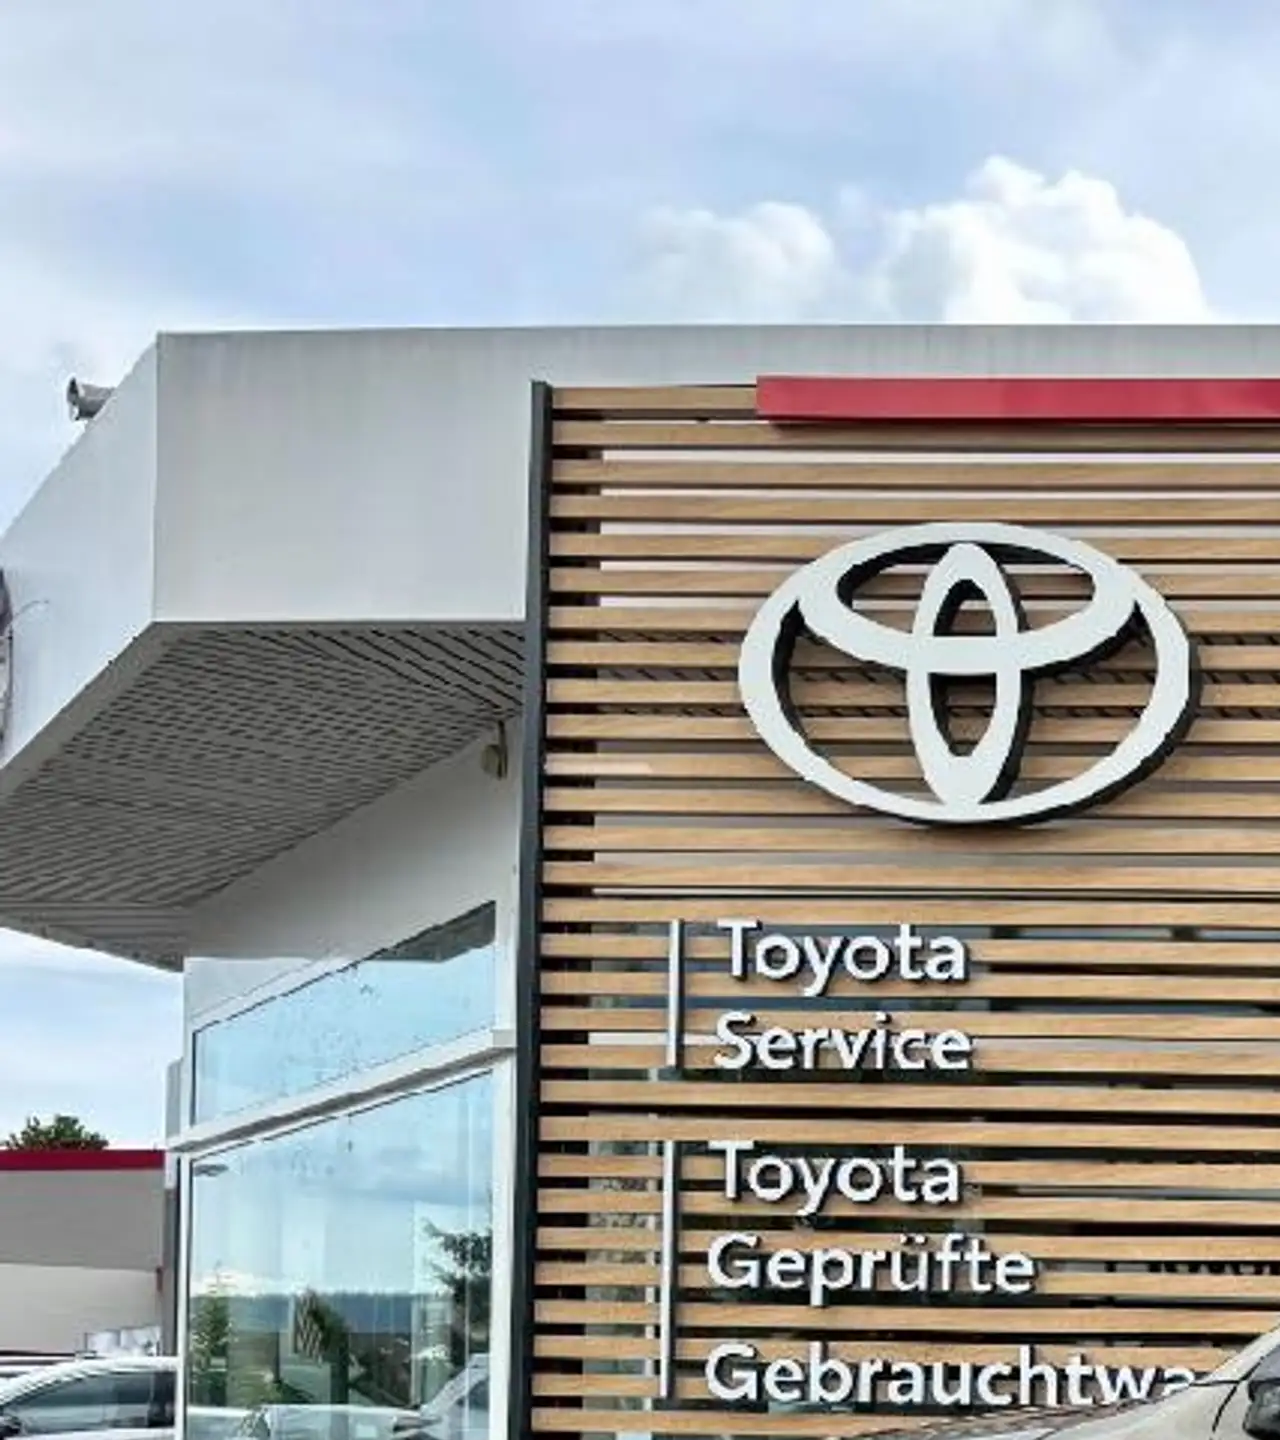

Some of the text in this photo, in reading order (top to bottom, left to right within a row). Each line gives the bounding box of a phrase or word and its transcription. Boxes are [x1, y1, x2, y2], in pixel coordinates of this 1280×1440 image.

[717, 917, 966, 997] Toyota
[714, 1010, 971, 1070] Service
[708, 1140, 961, 1217] Toyota
[707, 1233, 1037, 1307] Geprüfte
